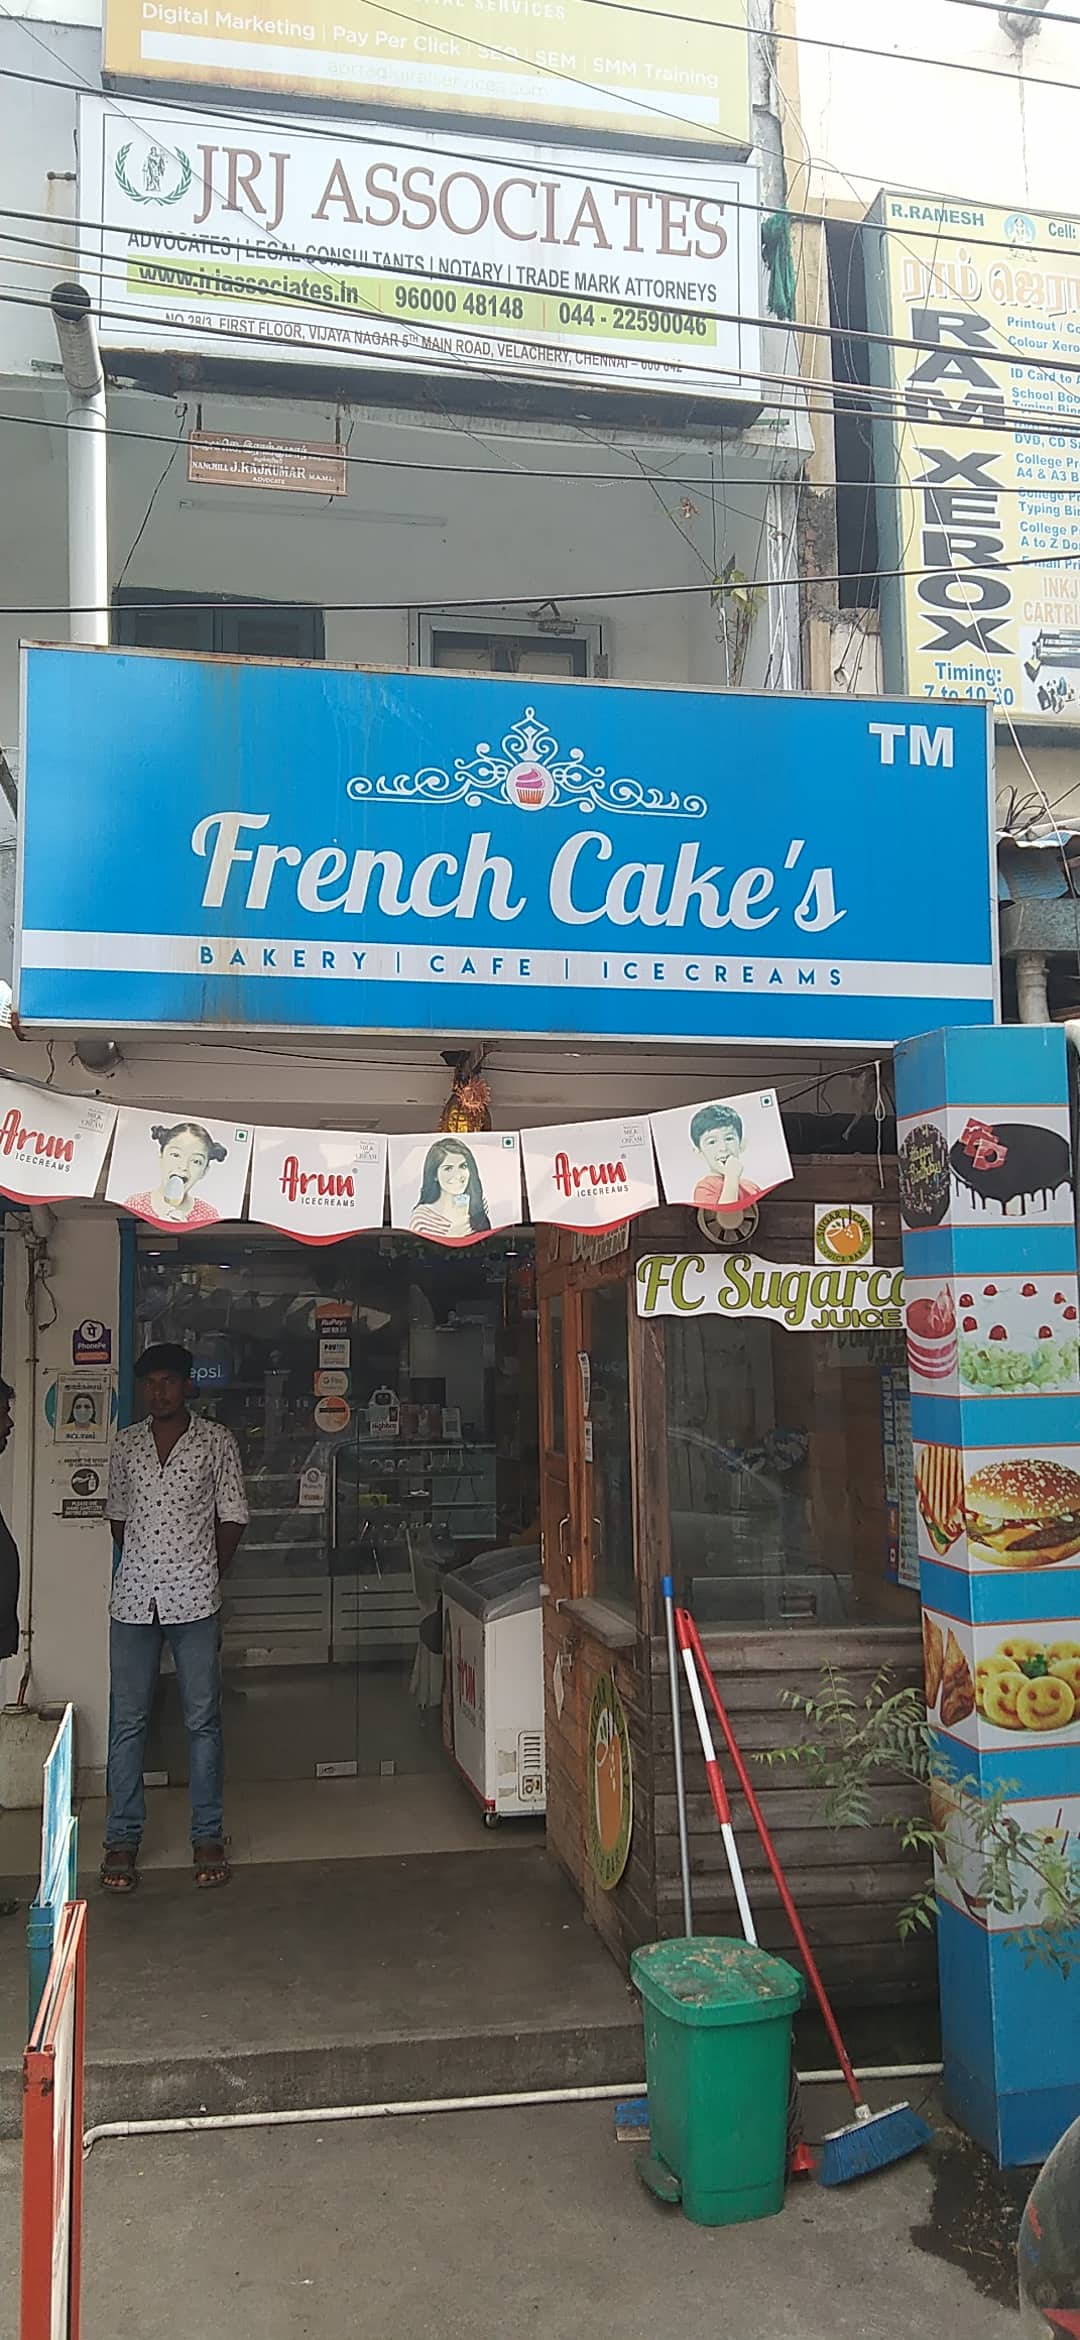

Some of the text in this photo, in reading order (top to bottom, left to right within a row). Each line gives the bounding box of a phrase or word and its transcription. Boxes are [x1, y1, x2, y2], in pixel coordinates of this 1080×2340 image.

[142, 3, 208, 25] Digital
[216, 11, 316, 40] Marketing
[333, 25, 369, 47] Pay
[376, 32, 407, 49] Per
[414, 36, 460, 56] Click
[536, 50, 576, 70] SEM
[593, 57, 636, 76] SMM
[645, 63, 718, 89] Training
[194, 143, 728, 260] JRJ ASSOCIATES
[892, 203, 1076, 240] R.RAMESH Cell:
[128, 229, 717, 302] ADVOCATES LEGAL CONSULTANTS NOTARY TRADE MARK ATTORNEYS
[902, 246, 981, 302] ராம்
[394, 285, 457, 313] 96000
[463, 291, 523, 319] 48148
[559, 302, 594, 326] 044
[613, 307, 706, 336] 22590046
[1007, 316, 1056, 331] Printout
[220, 317, 255, 333] FIRST
[259, 322, 305, 340] FLOOR,
[309, 326, 350, 343] VIJAYA
[354, 332, 399, 347] NAGAR
[422, 336, 452, 350] MAIN
[456, 339, 494, 356] ROAD,
[499, 344, 571, 366] VELACHERY,
[575, 350, 628, 368] CHENNAI
[1008, 335, 1048, 349] Colour
[1011, 368, 1023, 379] ID
[1027, 369, 1055, 382] Card
[1060, 373, 1072, 383] to
[1012, 387, 1053, 402] School
[1015, 433, 1045, 448] DVD,
[1048, 437, 1066, 448] CD
[1016, 452, 1062, 468] College
[1017, 467, 1032, 478] A4
[1051, 470, 1067, 481] A3
[1018, 487, 1064, 502] College
[1018, 501, 1060, 517] Typing
[1020, 521, 1066, 537] College
[911, 447, 1016, 655] XEROX
[1020, 535, 1029, 547] A
[1033, 537, 1046, 548] to
[1050, 538, 1058, 549] Z
[934, 662, 1001, 686] Timing:
[869, 722, 954, 768] TM
[191, 812, 847, 932] French Cake's
[200, 946, 844, 986] BAKERY CAFE ICECREAMS
[0, 1109, 74, 1162] Arun
[15, 1153, 71, 1172] ICECREAMS
[279, 1156, 356, 1202] Arun
[553, 1152, 627, 1197] Arun
[576, 1184, 630, 1198] ICECREAMS
[301, 1197, 356, 1208] ICECREAMS
[816, 1210, 871, 1237] SUGAR CANE
[638, 1255, 705, 1310] FC
[811, 1308, 903, 1328] JUICE
[77, 1342, 107, 1350] PhonePe
[190, 1365, 222, 1380] epsi
